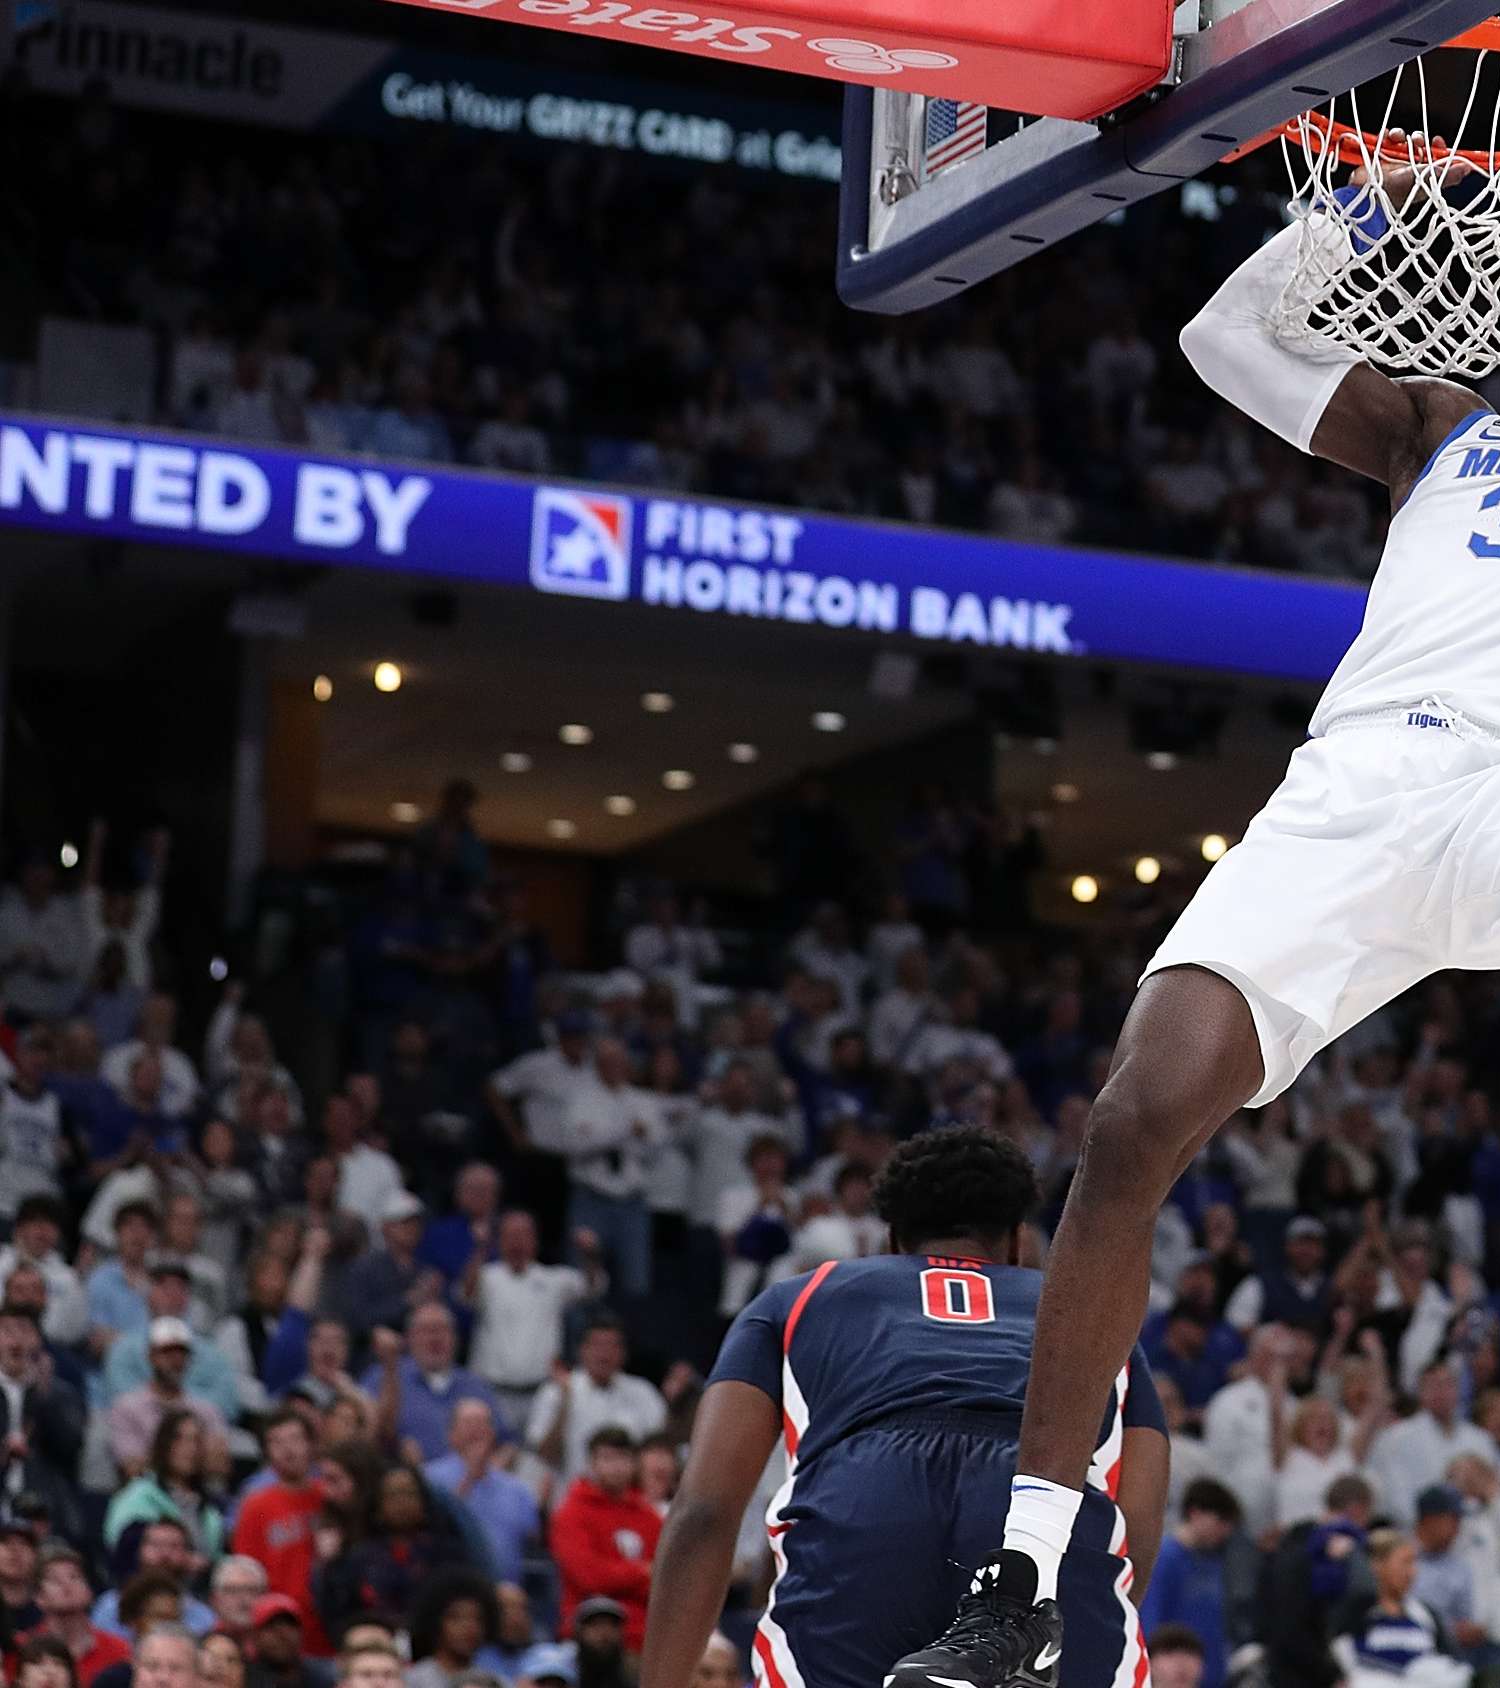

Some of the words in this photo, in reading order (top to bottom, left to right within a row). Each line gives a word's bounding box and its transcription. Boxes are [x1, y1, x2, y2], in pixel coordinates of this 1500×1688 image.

[518, 0, 802, 52] State
[294, 463, 431, 553] BY
[645, 500, 803, 564] FIRST
[642, 556, 900, 631] HORIZON
[910, 588, 1072, 655] BANK
[1407, 712, 1455, 729] Tiger
[920, 1268, 996, 1324] 0
